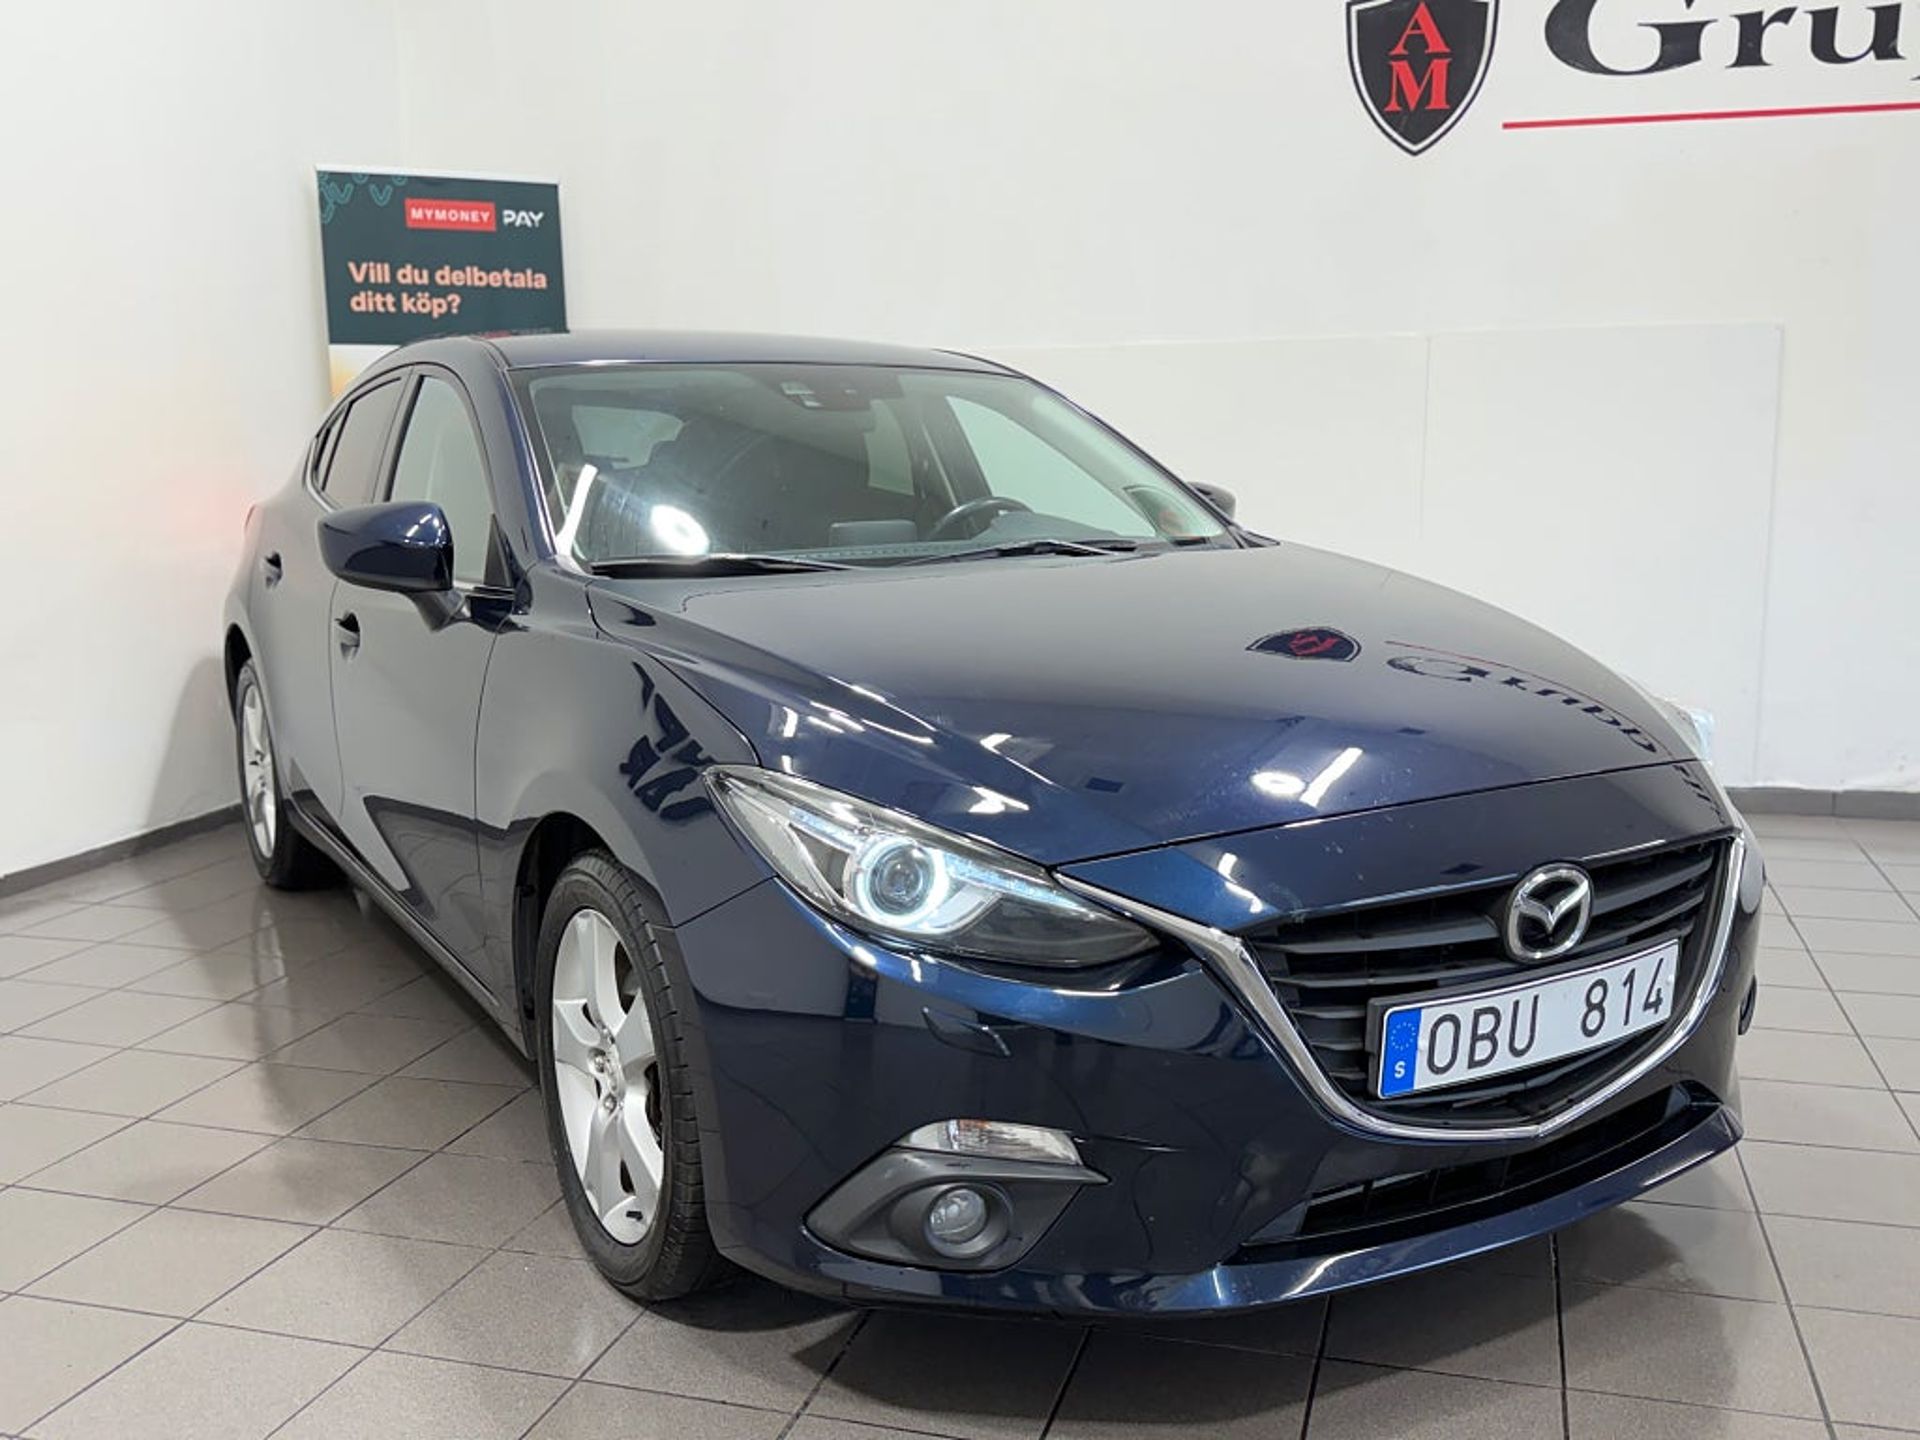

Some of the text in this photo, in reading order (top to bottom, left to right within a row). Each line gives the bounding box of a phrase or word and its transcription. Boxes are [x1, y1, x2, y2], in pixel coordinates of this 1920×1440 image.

[1545, 0, 1920, 81] Gru
[410, 208, 544, 227] MYMONEY PAY
[348, 261, 548, 289] Vill du delbetala
[350, 291, 461, 318] ditt köp?
[1427, 957, 1672, 1076] OBU 814
[1394, 1060, 1406, 1079] S
